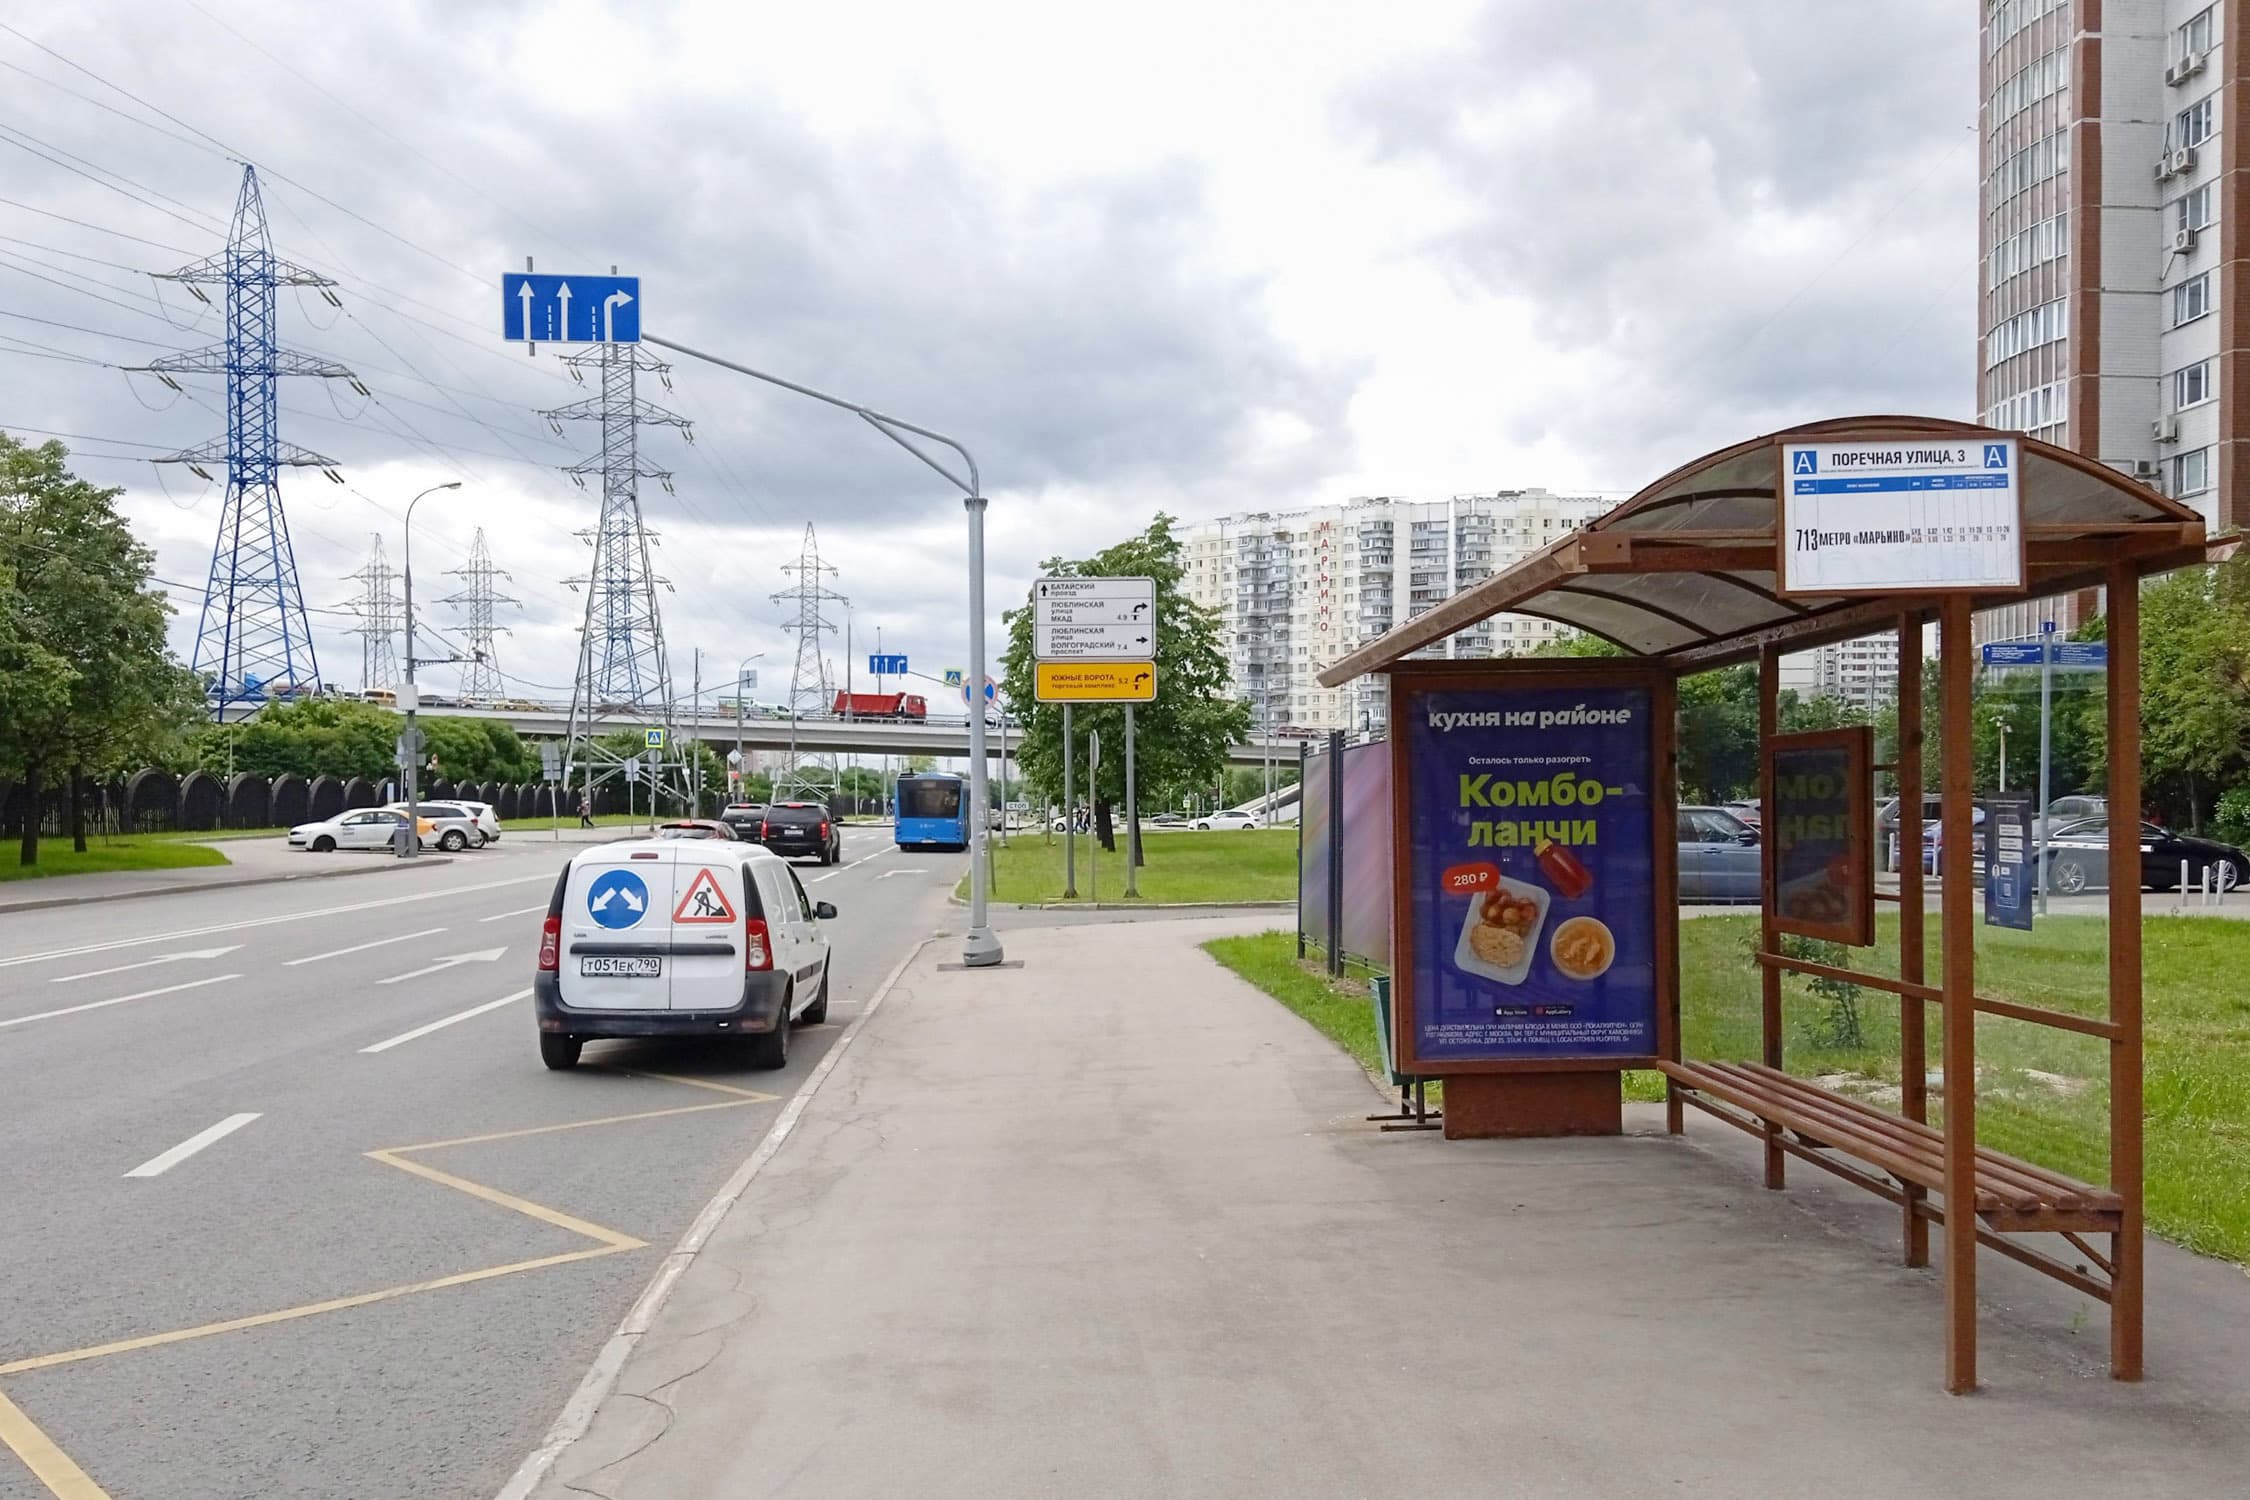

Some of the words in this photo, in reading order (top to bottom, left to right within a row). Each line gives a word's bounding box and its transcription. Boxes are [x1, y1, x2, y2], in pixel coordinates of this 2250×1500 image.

[1832, 452, 1902, 467] ПОРЕЧНАЯ
[1906, 450, 1954, 466] УЛИЦА,
[1958, 450, 1966, 463] 3
[1796, 529, 1818, 551] 713
[1819, 531, 1850, 546] МЕТРО
[1853, 530, 1911, 545] «МАРЬИНО»
[1319, 521, 1330, 632] МАРЬИНО
[1429, 710, 1500, 732] кухня
[1505, 711, 1535, 727] на
[1540, 704, 1631, 729] районе
[1469, 756, 1512, 765] Осталось
[1514, 756, 1544, 765] только
[1546, 756, 1592, 766] разогреть
[1459, 772, 1623, 808] Комбо-
[1467, 819, 1597, 848] ланчи
[1453, 873, 1477, 887] 280
[587, 959, 635, 972] Т051ЕК
[637, 959, 657, 969] 790
